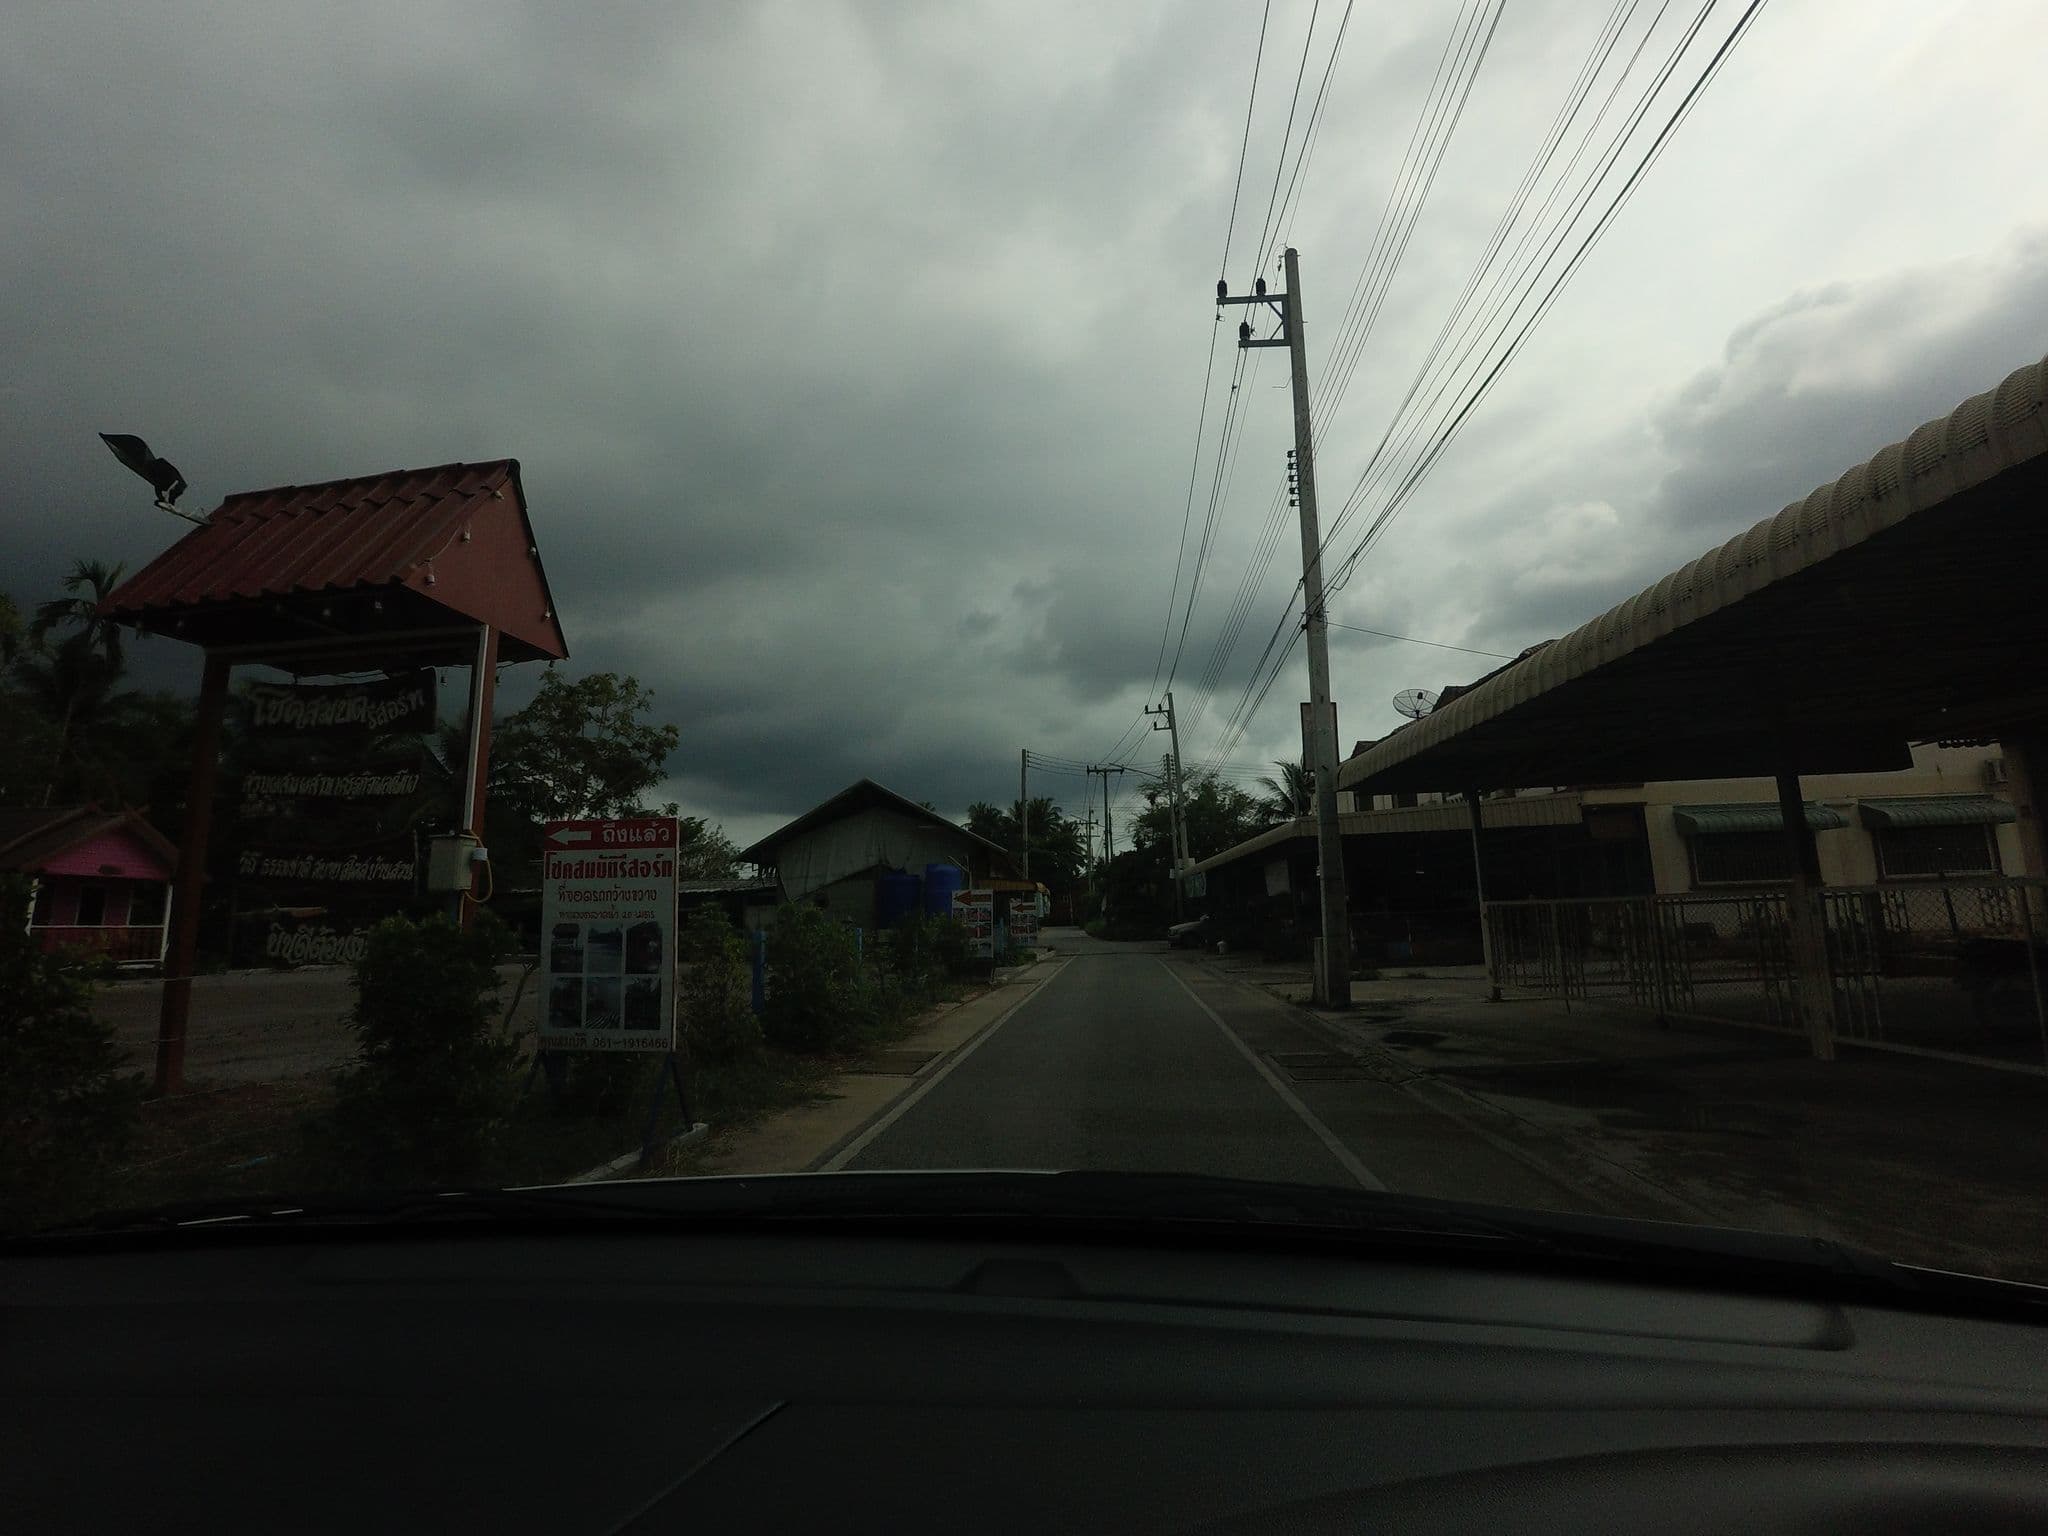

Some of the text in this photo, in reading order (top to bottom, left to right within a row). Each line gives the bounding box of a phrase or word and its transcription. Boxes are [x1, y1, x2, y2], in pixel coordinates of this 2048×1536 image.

[602, 821, 670, 843] ถึงแล้ว
[558, 881, 657, 902] ที่จอดรถกว้างขวาง
